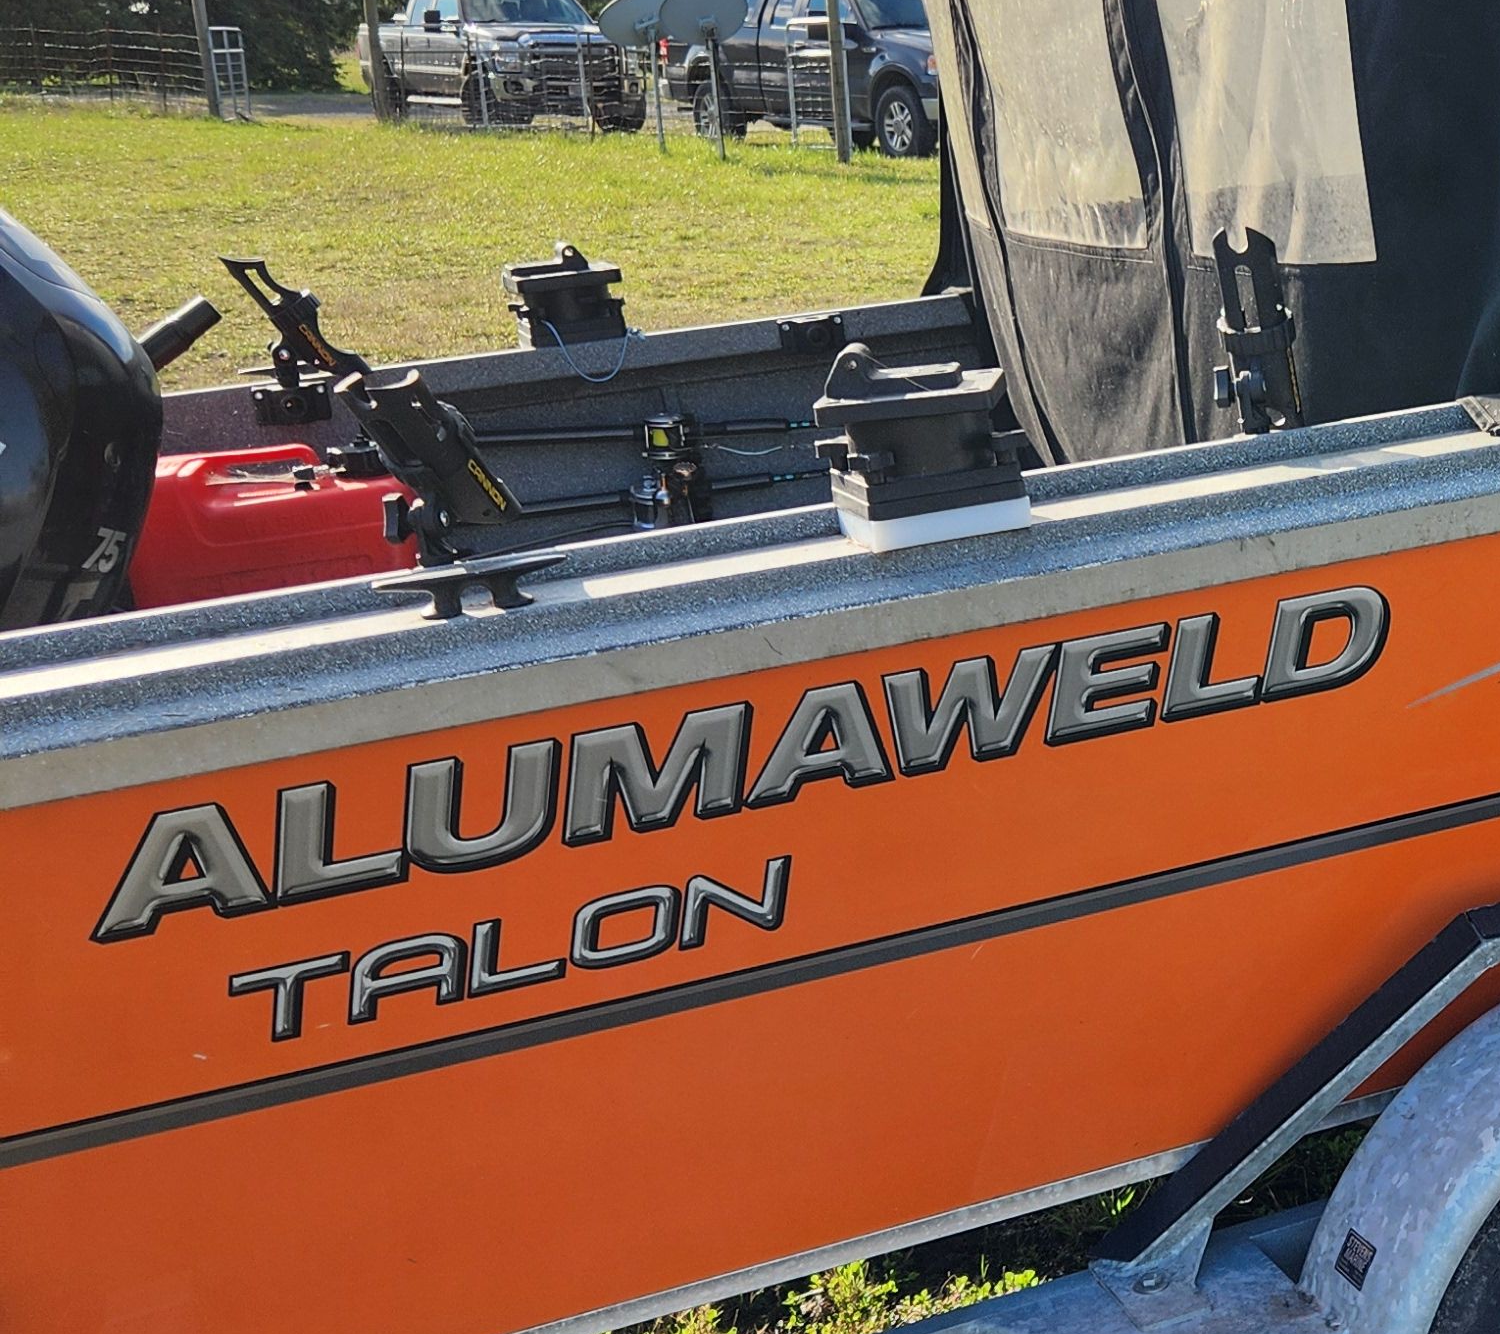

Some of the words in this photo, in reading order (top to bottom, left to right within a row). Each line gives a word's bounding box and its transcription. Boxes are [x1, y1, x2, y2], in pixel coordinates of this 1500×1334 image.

[468, 458, 507, 511] CANNON
[81, 526, 128, 573] 75
[90, 585, 1390, 945] ALUMAWELD
[229, 855, 792, 1043] TALON
